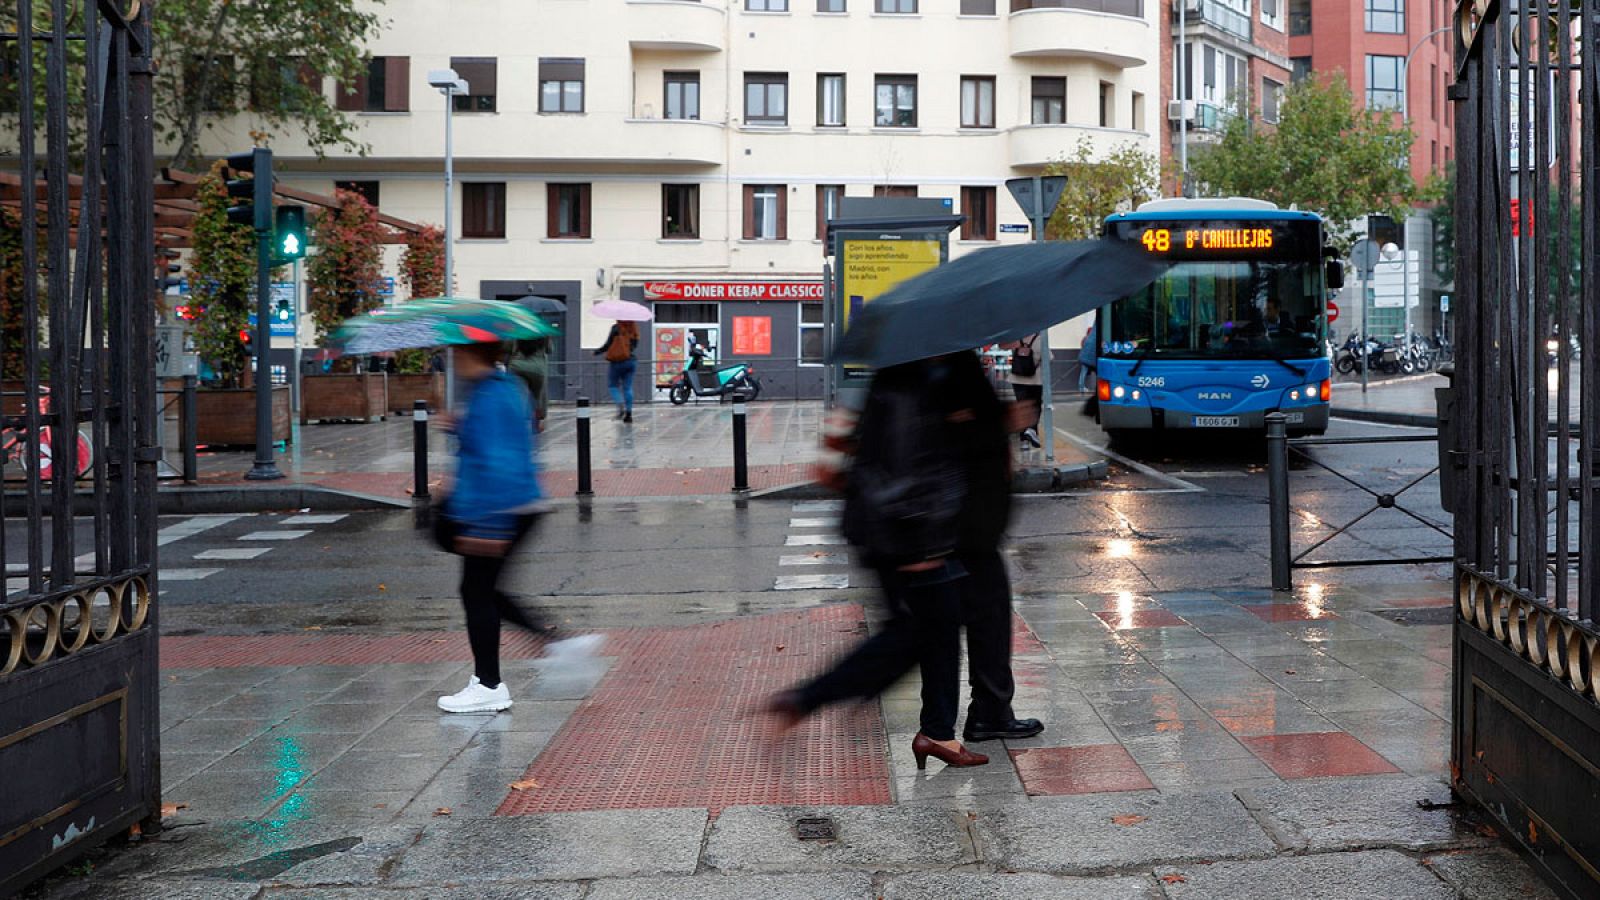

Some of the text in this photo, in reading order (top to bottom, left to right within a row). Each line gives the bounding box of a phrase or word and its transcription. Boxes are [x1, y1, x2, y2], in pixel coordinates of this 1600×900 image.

[1141, 228, 1170, 252] 48
[1202, 229, 1273, 248] CANILLEJAS
[727, 285, 766, 297] KEBAP
[769, 285, 824, 297] CLASSICO
[1138, 376, 1165, 388] 5246
[1198, 392, 1232, 400] MAN
